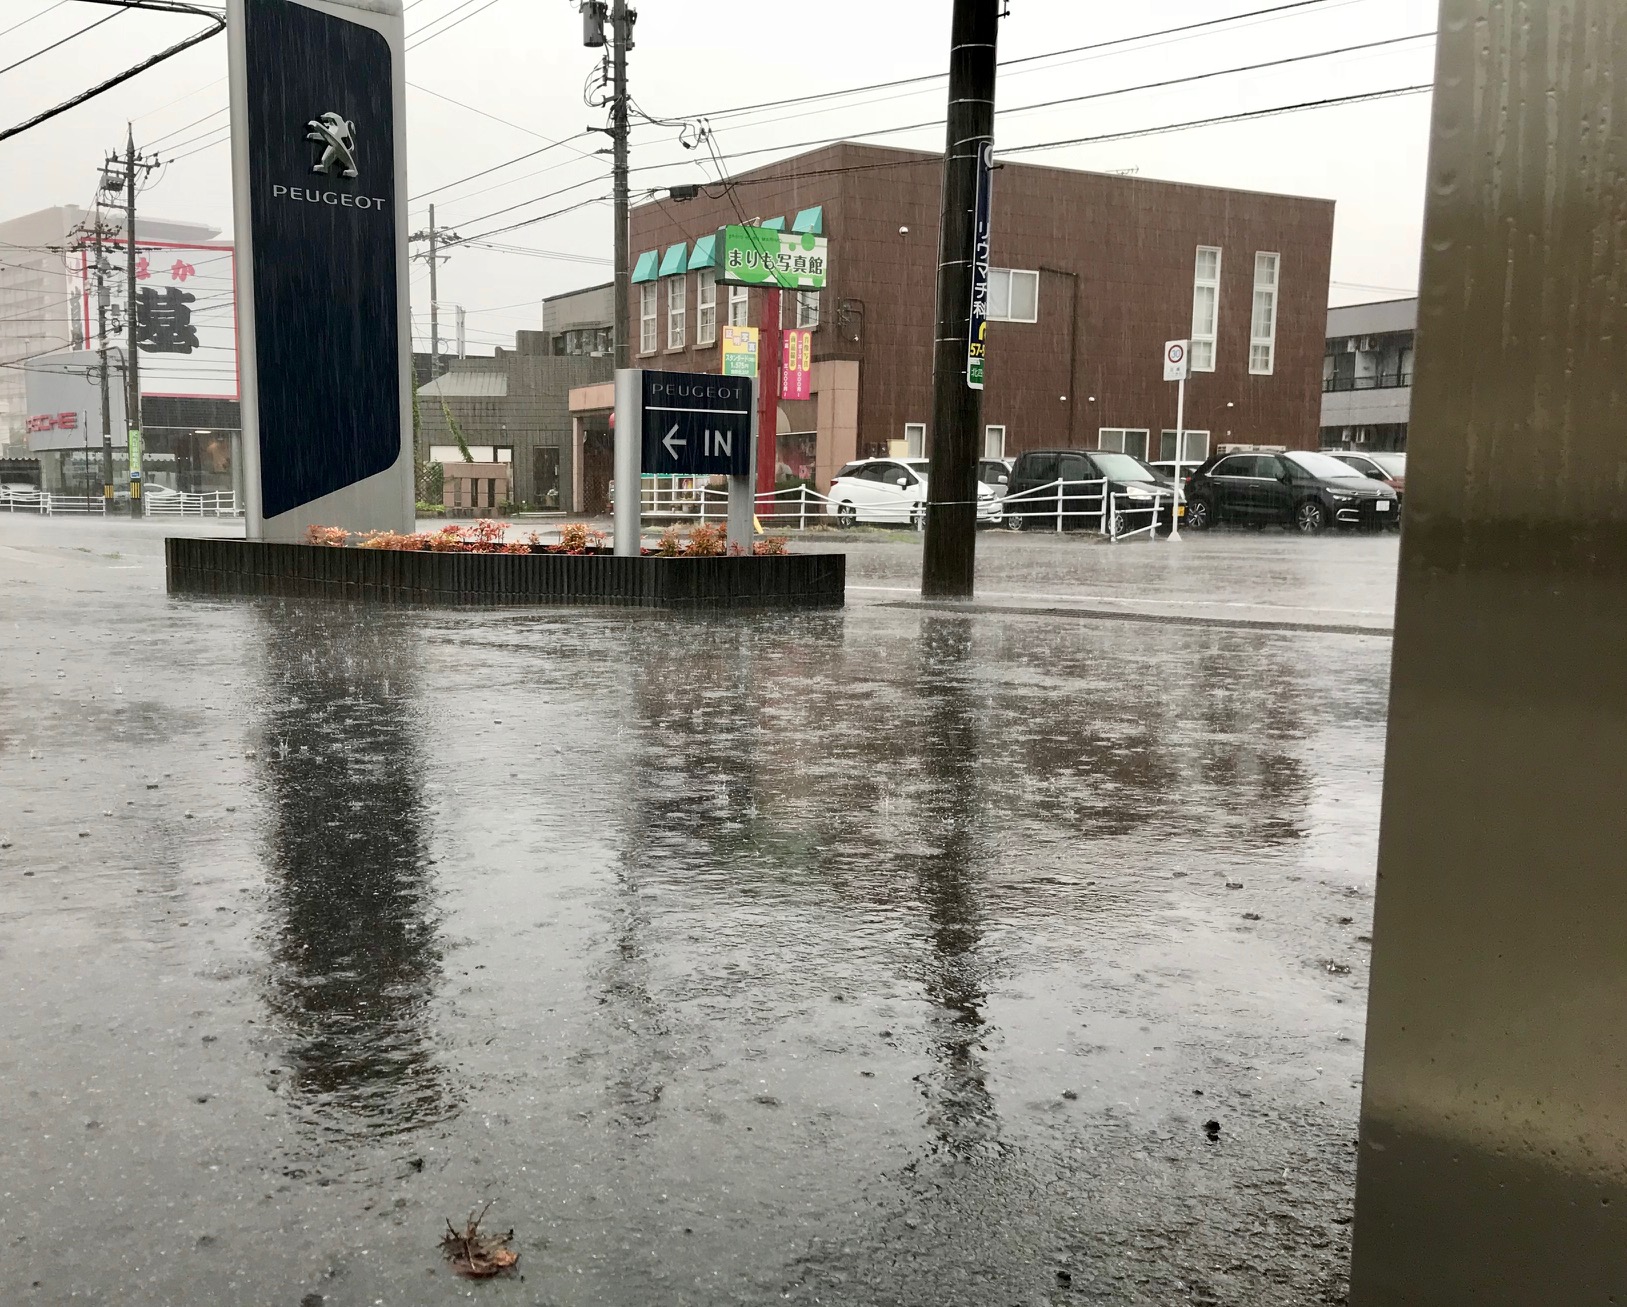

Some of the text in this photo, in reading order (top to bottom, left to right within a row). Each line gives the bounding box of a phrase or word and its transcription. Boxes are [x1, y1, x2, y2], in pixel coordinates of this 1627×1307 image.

[272, 184, 386, 211] PEUGEOT
[729, 248, 823, 275] まりも写真館
[1171, 349, 1181, 359] 30
[652, 383, 742, 399] PEUGEOT
[704, 429, 733, 457] IN
